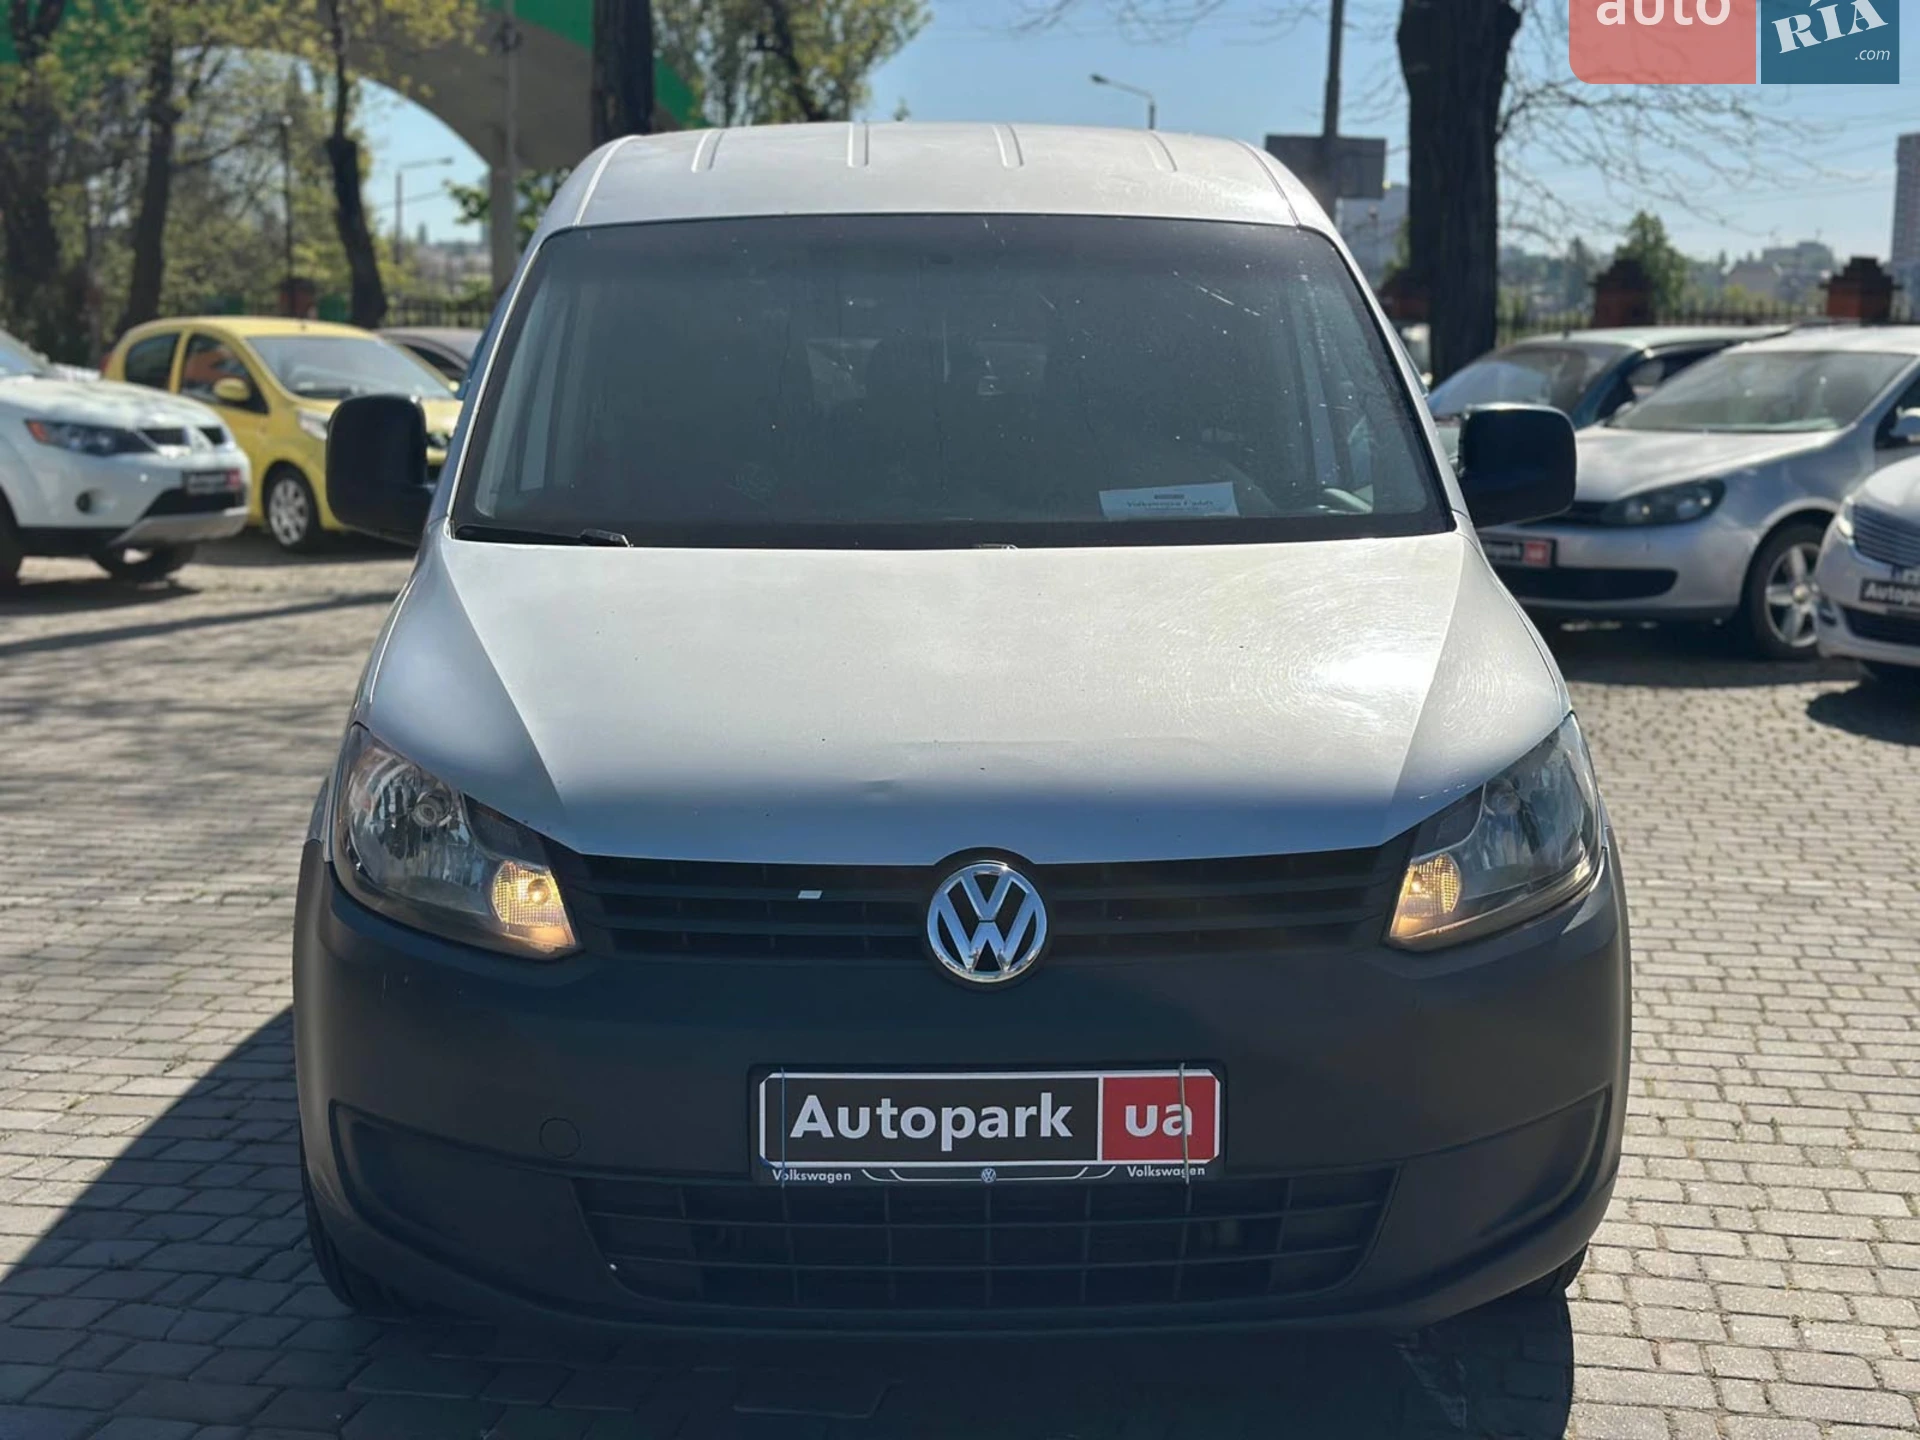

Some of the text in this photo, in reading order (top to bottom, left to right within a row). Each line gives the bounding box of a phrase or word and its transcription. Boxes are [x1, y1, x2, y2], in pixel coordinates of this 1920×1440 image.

[789, 1092, 1193, 1152] Autopark ua
[772, 1168, 852, 1184] Volkswagen
